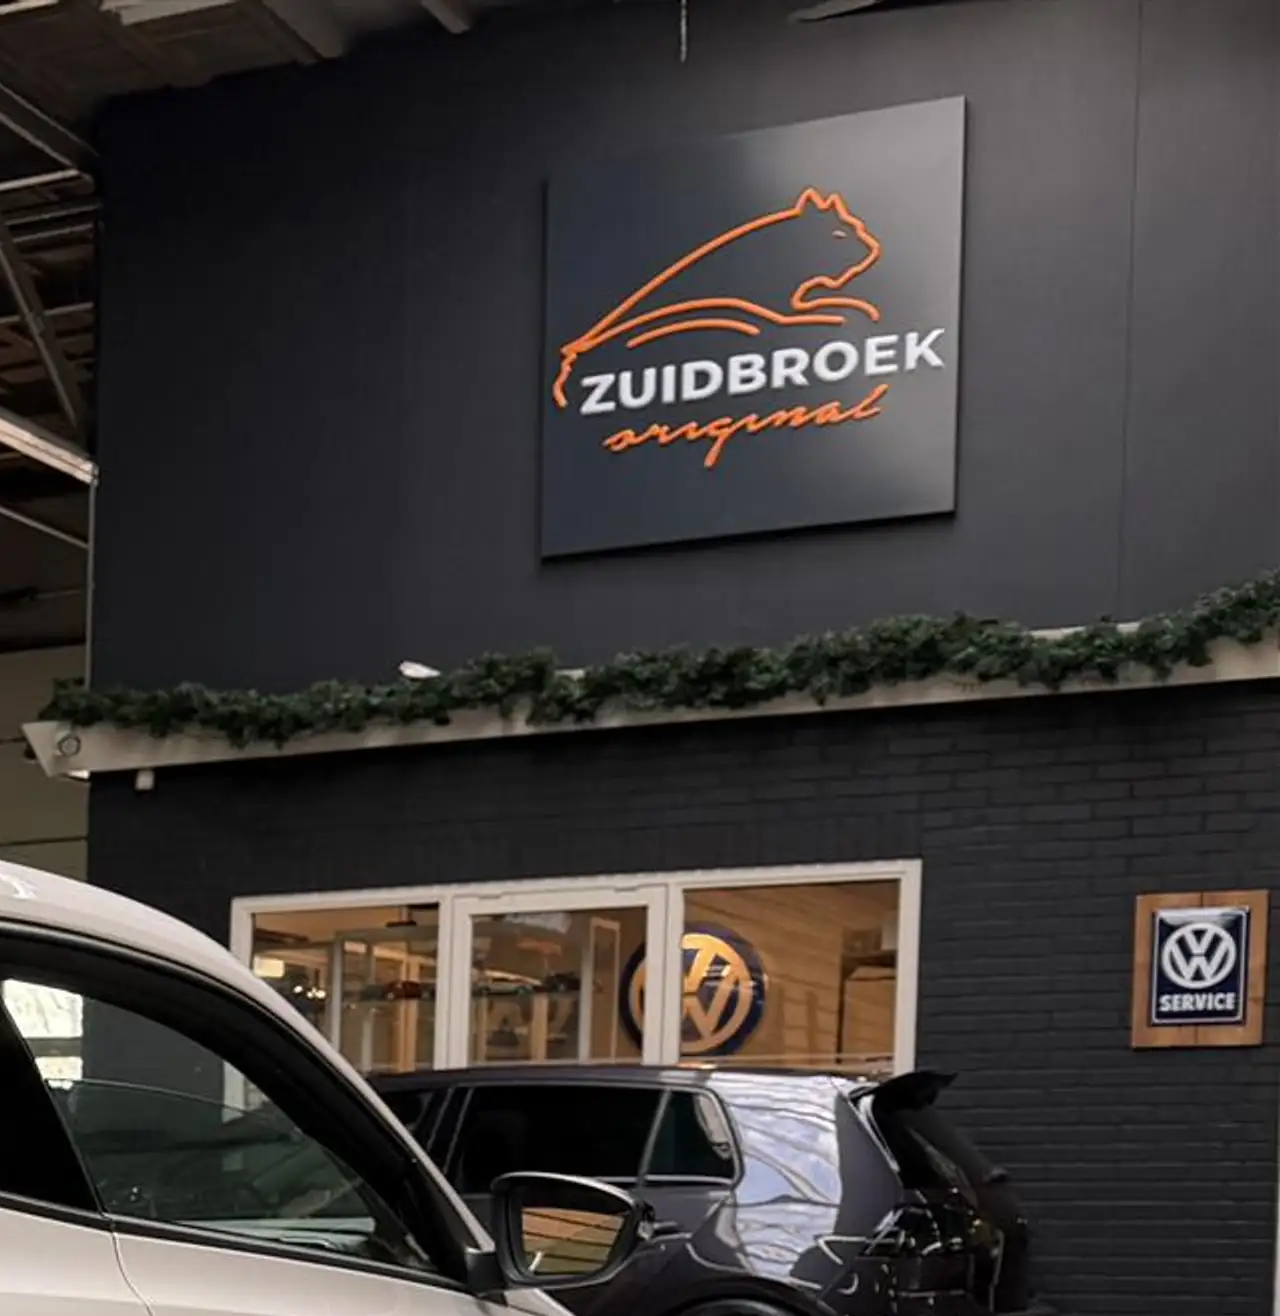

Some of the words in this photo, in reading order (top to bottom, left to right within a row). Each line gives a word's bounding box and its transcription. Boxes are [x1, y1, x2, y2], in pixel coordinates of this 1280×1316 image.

[580, 328, 945, 414] ZUIDBROEK
[603, 384, 889, 468] original
[1158, 992, 1236, 1012] SERVICE
